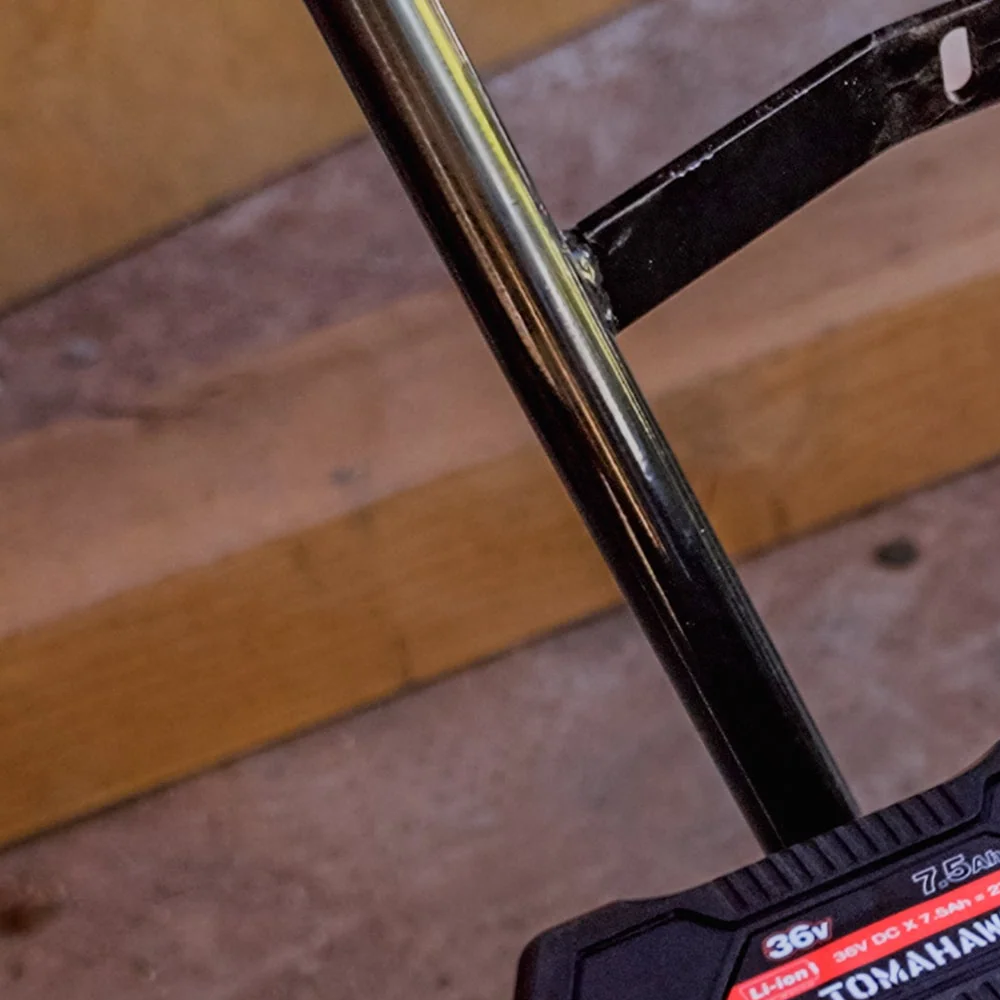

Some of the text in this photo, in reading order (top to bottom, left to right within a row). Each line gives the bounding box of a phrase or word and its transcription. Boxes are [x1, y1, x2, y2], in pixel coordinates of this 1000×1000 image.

[832, 939, 868, 963] 36V
[871, 925, 901, 946] DC
[919, 897, 972, 920] 7.5Ah
